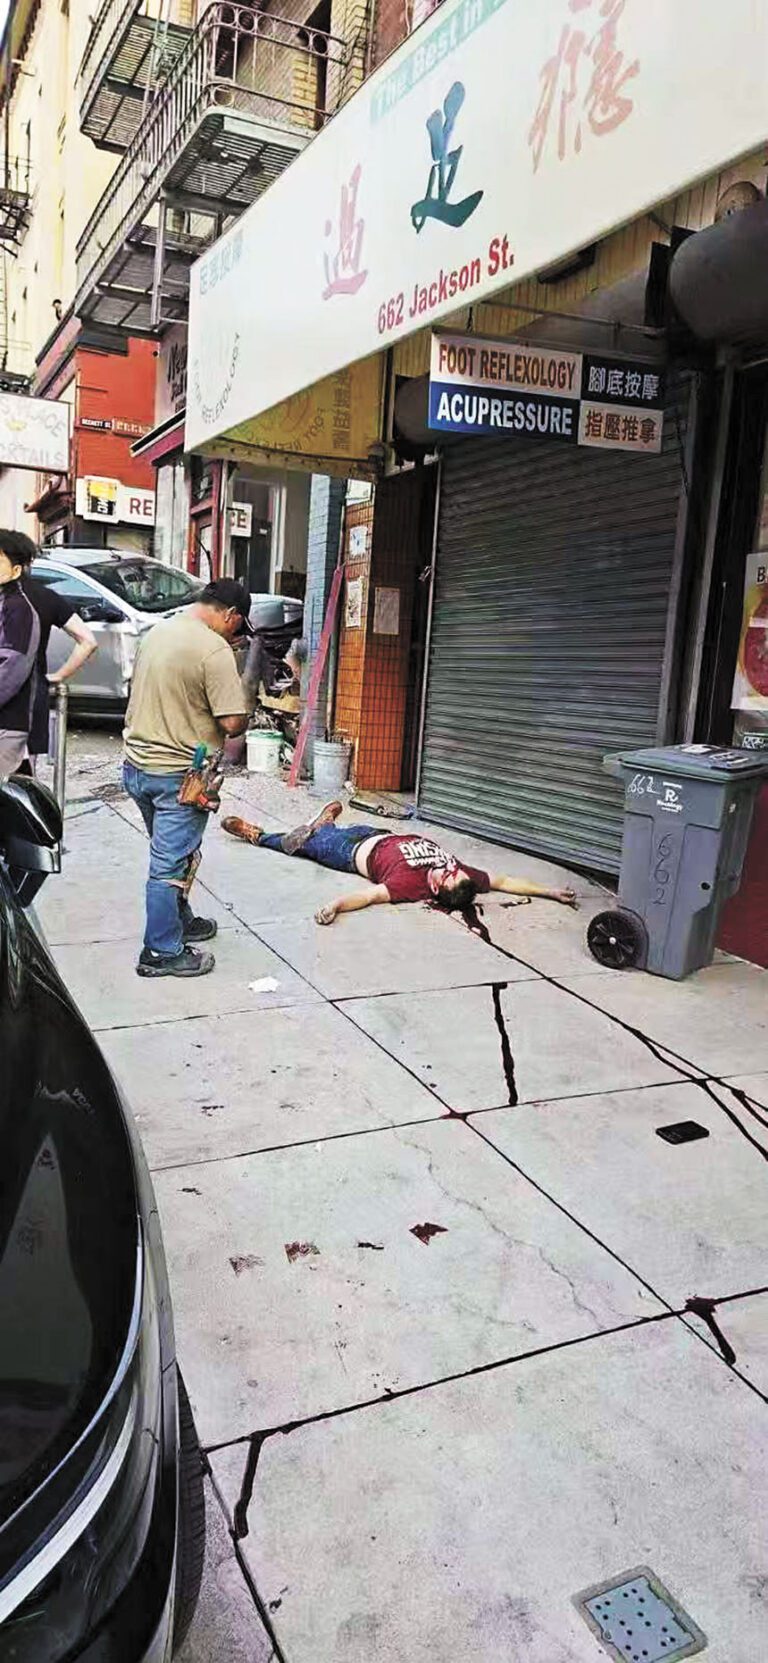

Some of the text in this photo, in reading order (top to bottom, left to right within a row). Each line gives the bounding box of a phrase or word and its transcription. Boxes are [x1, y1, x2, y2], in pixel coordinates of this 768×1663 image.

[412, 14, 457, 79] Best
[377, 234, 515, 335] 662 Jackson St.
[438, 343, 576, 392] FOOT REFLEXOLOGY
[588, 365, 660, 401] 腳底按摩
[436, 391, 574, 435] ACUPRESSURE
[584, 408, 658, 445] 指壓推拿
[627, 773, 660, 795] 662
[653, 832, 673, 905] 662
